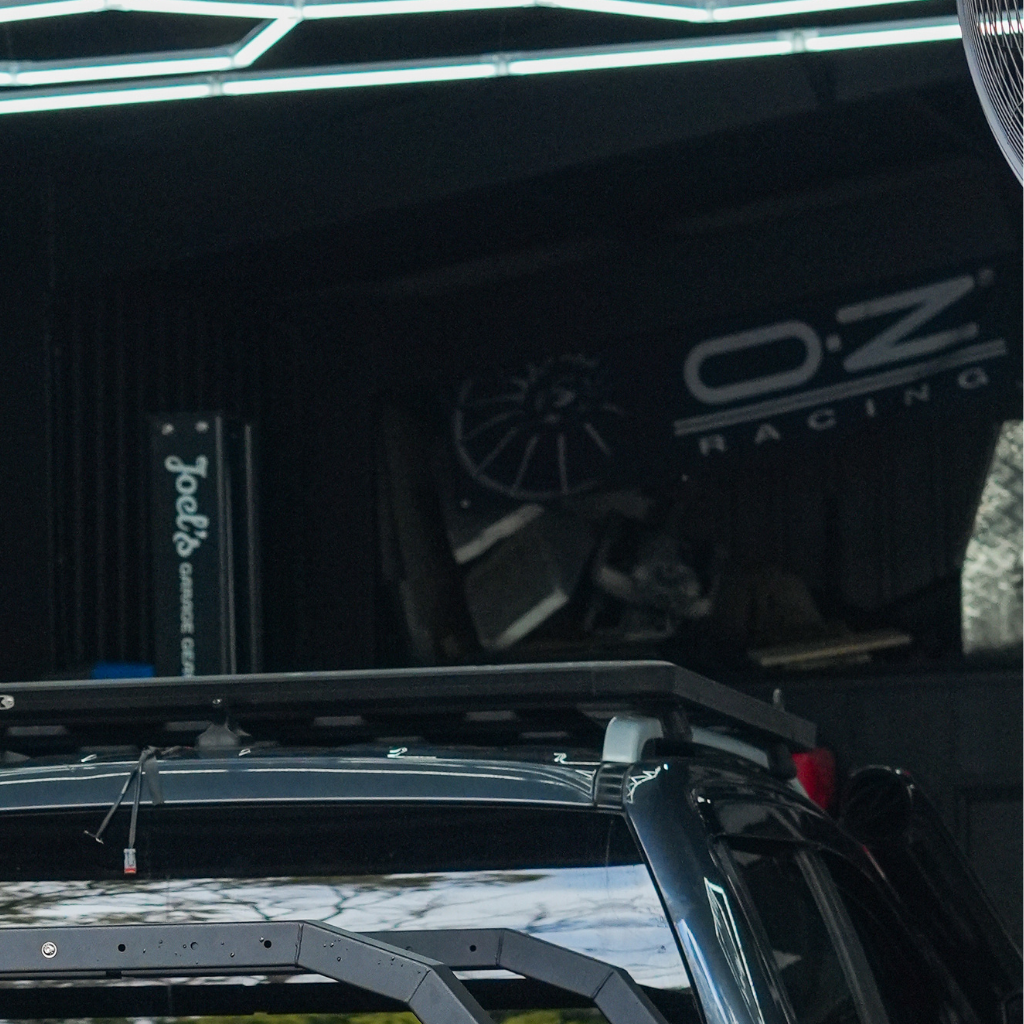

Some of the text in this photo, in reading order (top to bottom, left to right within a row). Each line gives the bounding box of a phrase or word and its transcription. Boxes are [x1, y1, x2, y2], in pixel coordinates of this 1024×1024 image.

[698, 365, 989, 456] RACING
[164, 455, 210, 558] Joel's
[179, 562, 194, 634] GARAGE
